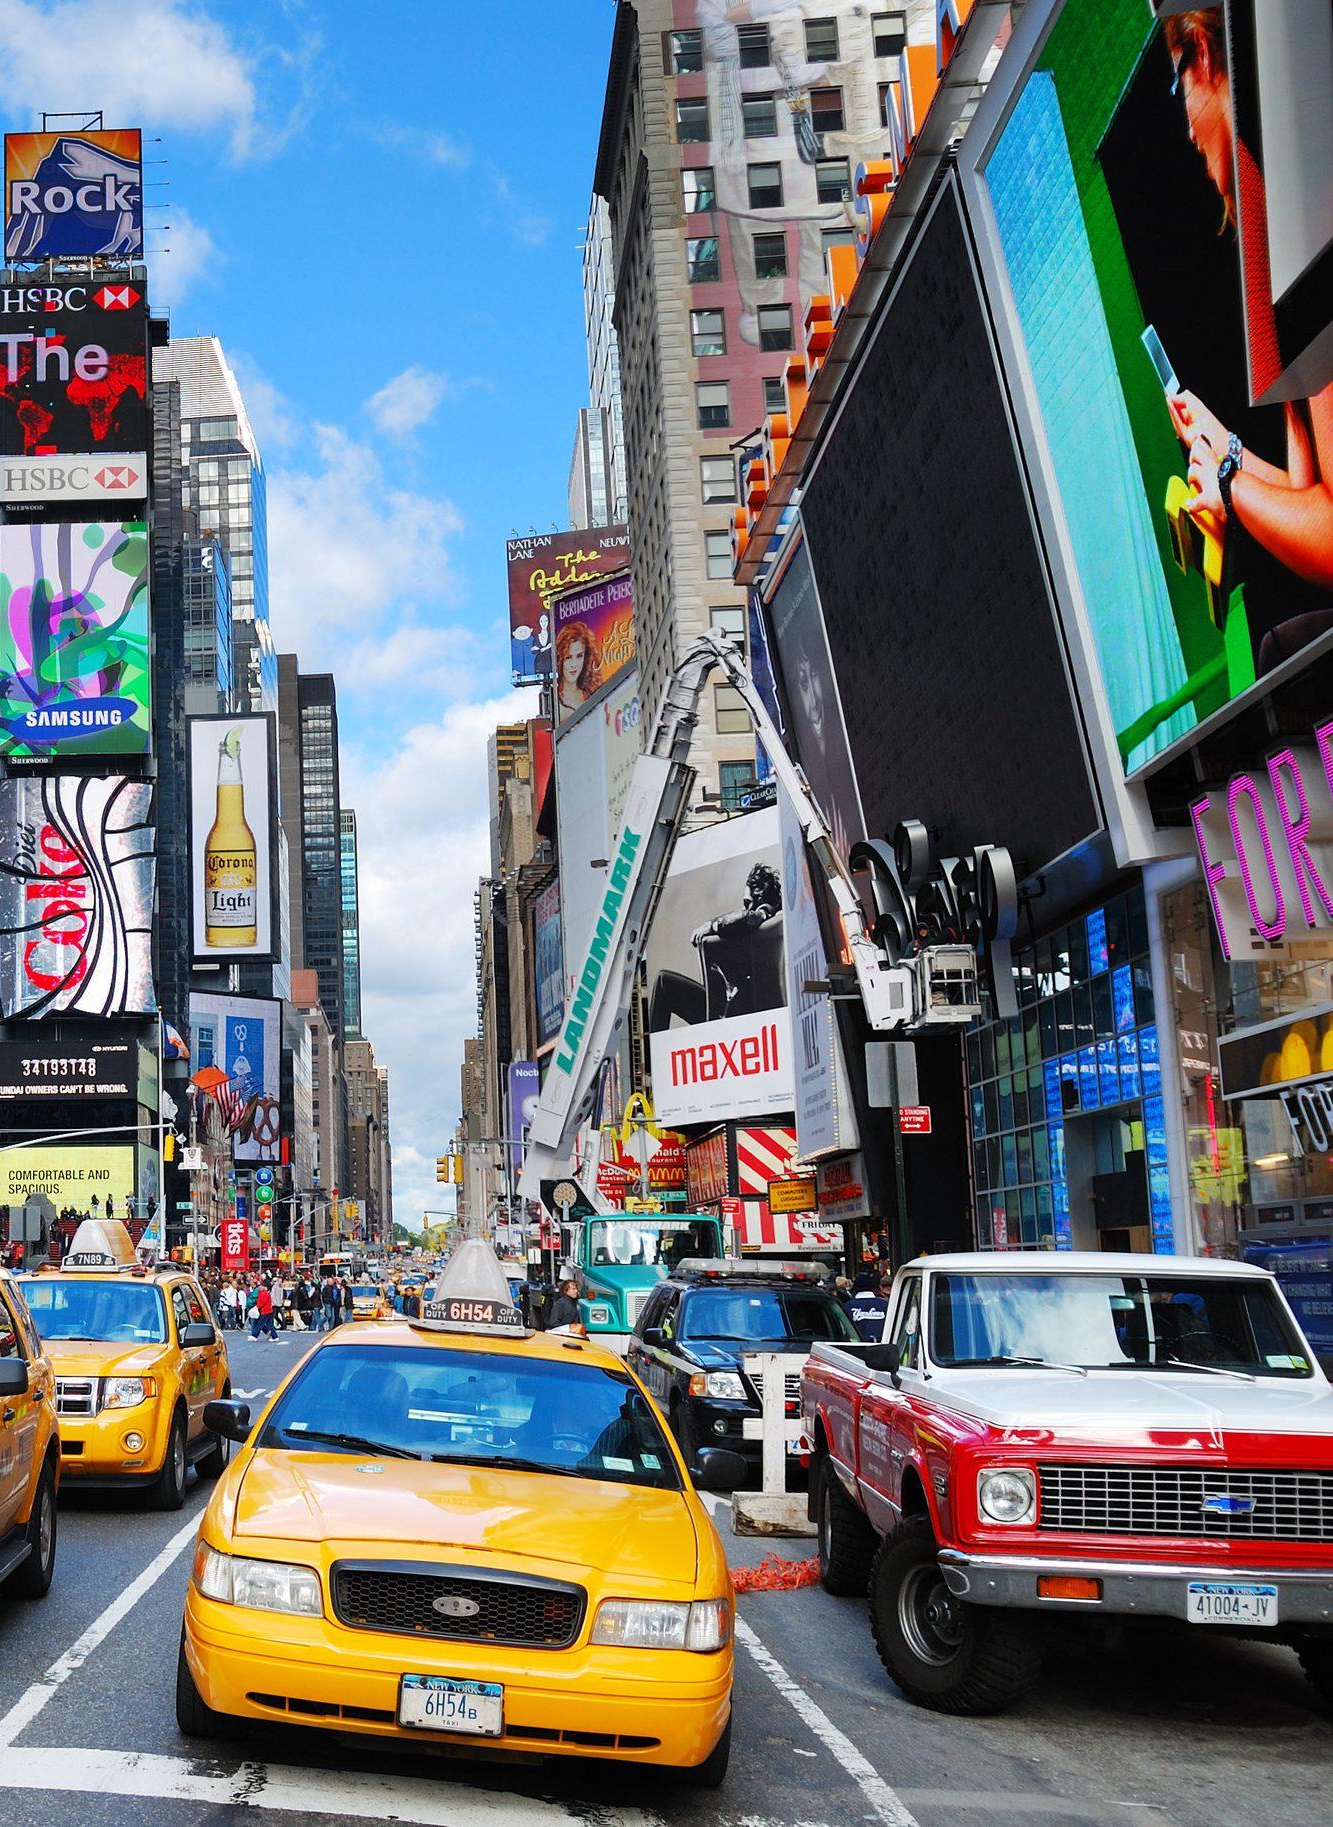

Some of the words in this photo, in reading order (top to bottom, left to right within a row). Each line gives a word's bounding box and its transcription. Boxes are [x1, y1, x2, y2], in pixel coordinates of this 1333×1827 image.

[10, 175, 134, 215] Rock
[1, 287, 87, 313] HSBC
[4, 466, 89, 493] HSBC
[6, 504, 45, 512] SHERWOOD
[508, 536, 552, 550] NATHAN
[508, 549, 534, 561] LANE
[556, 550, 602, 567] The
[559, 591, 605, 620] BERNADETTE
[26, 709, 123, 727] SAMSUNG
[11, 756, 50, 765] SHERWOOD
[16, 821, 37, 886] Diet
[207, 854, 255, 873] Corona
[210, 890, 252, 911] Light
[556, 825, 642, 1075] LANDMARK
[670, 1023, 780, 1087] maxell
[25, 1085, 58, 1095] OWNERS
[59, 1085, 83, 1094] CAN'T
[85, 1085, 95, 1094] BE
[97, 1084, 128, 1093] WRONG.
[8, 1170, 85, 1181] COMFORTABLE
[87, 1169, 110, 1180] AND
[8, 1183, 63, 1195] SPACIOUS.
[227, 1222, 242, 1255] tkts
[77, 1253, 103, 1265] 7N89
[426, 1310, 447, 1319] DUTY
[497, 1316, 518, 1325] DUTY
[430, 1303, 446, 1311] OFF
[450, 1300, 494, 1322] 6H54
[500, 1308, 515, 1317] OFF
[1211, 1587, 1229, 1595] NEW
[1233, 1588, 1256, 1596] YORK
[426, 1681, 449, 1691] NEW
[453, 1683, 480, 1695] YORK
